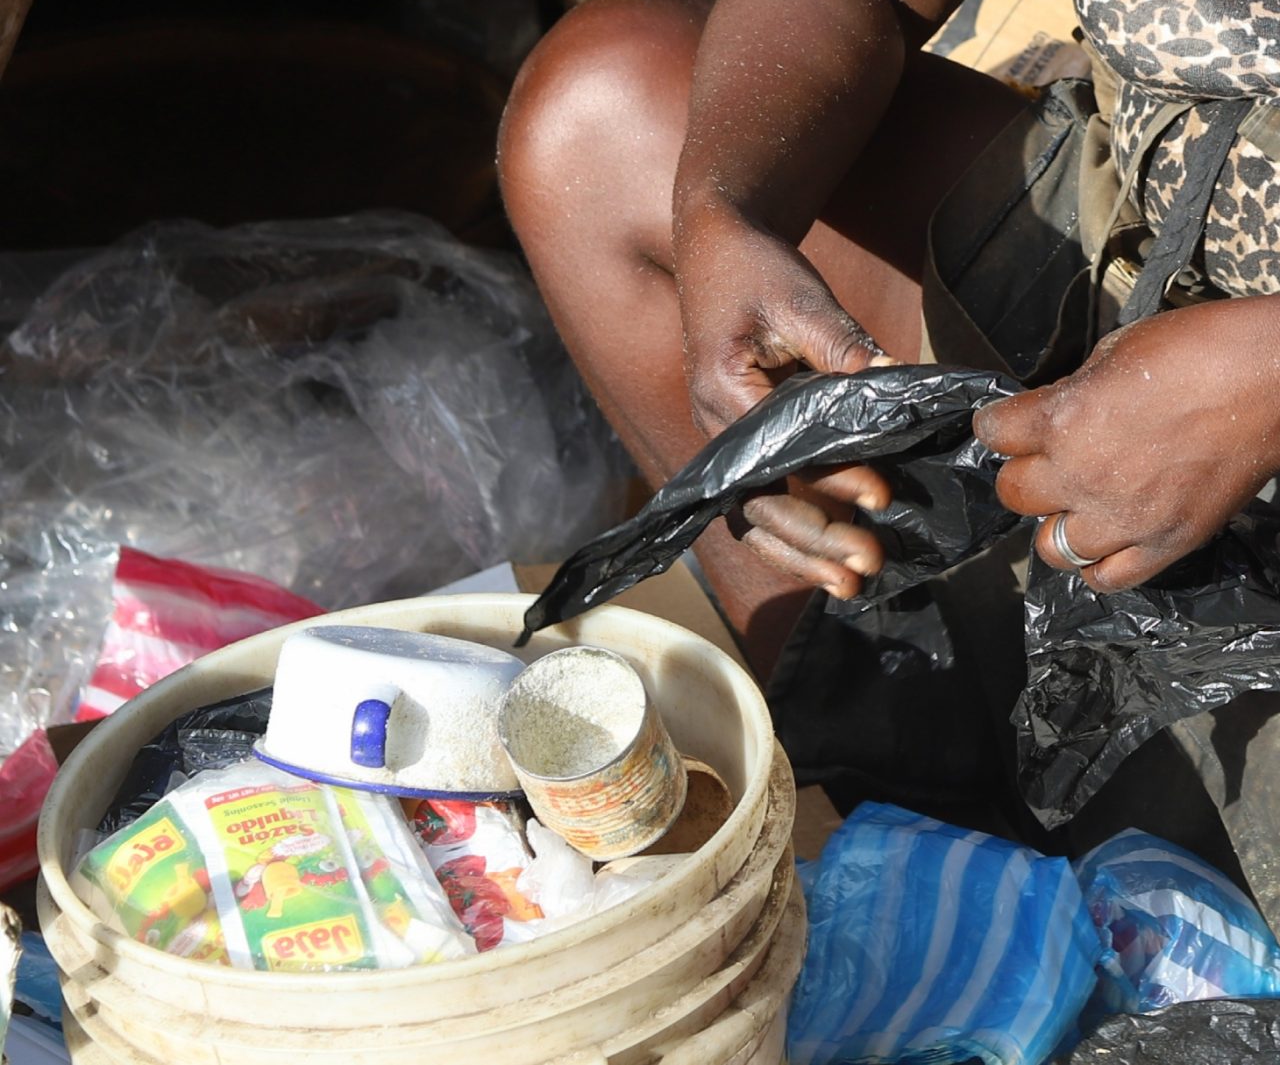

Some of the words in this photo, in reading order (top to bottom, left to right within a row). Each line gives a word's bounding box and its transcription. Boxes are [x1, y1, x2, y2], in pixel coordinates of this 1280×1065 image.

[223, 800, 277, 816] Seasoning
[238, 824, 315, 845] Sazón
[272, 925, 350, 959] Jaja
